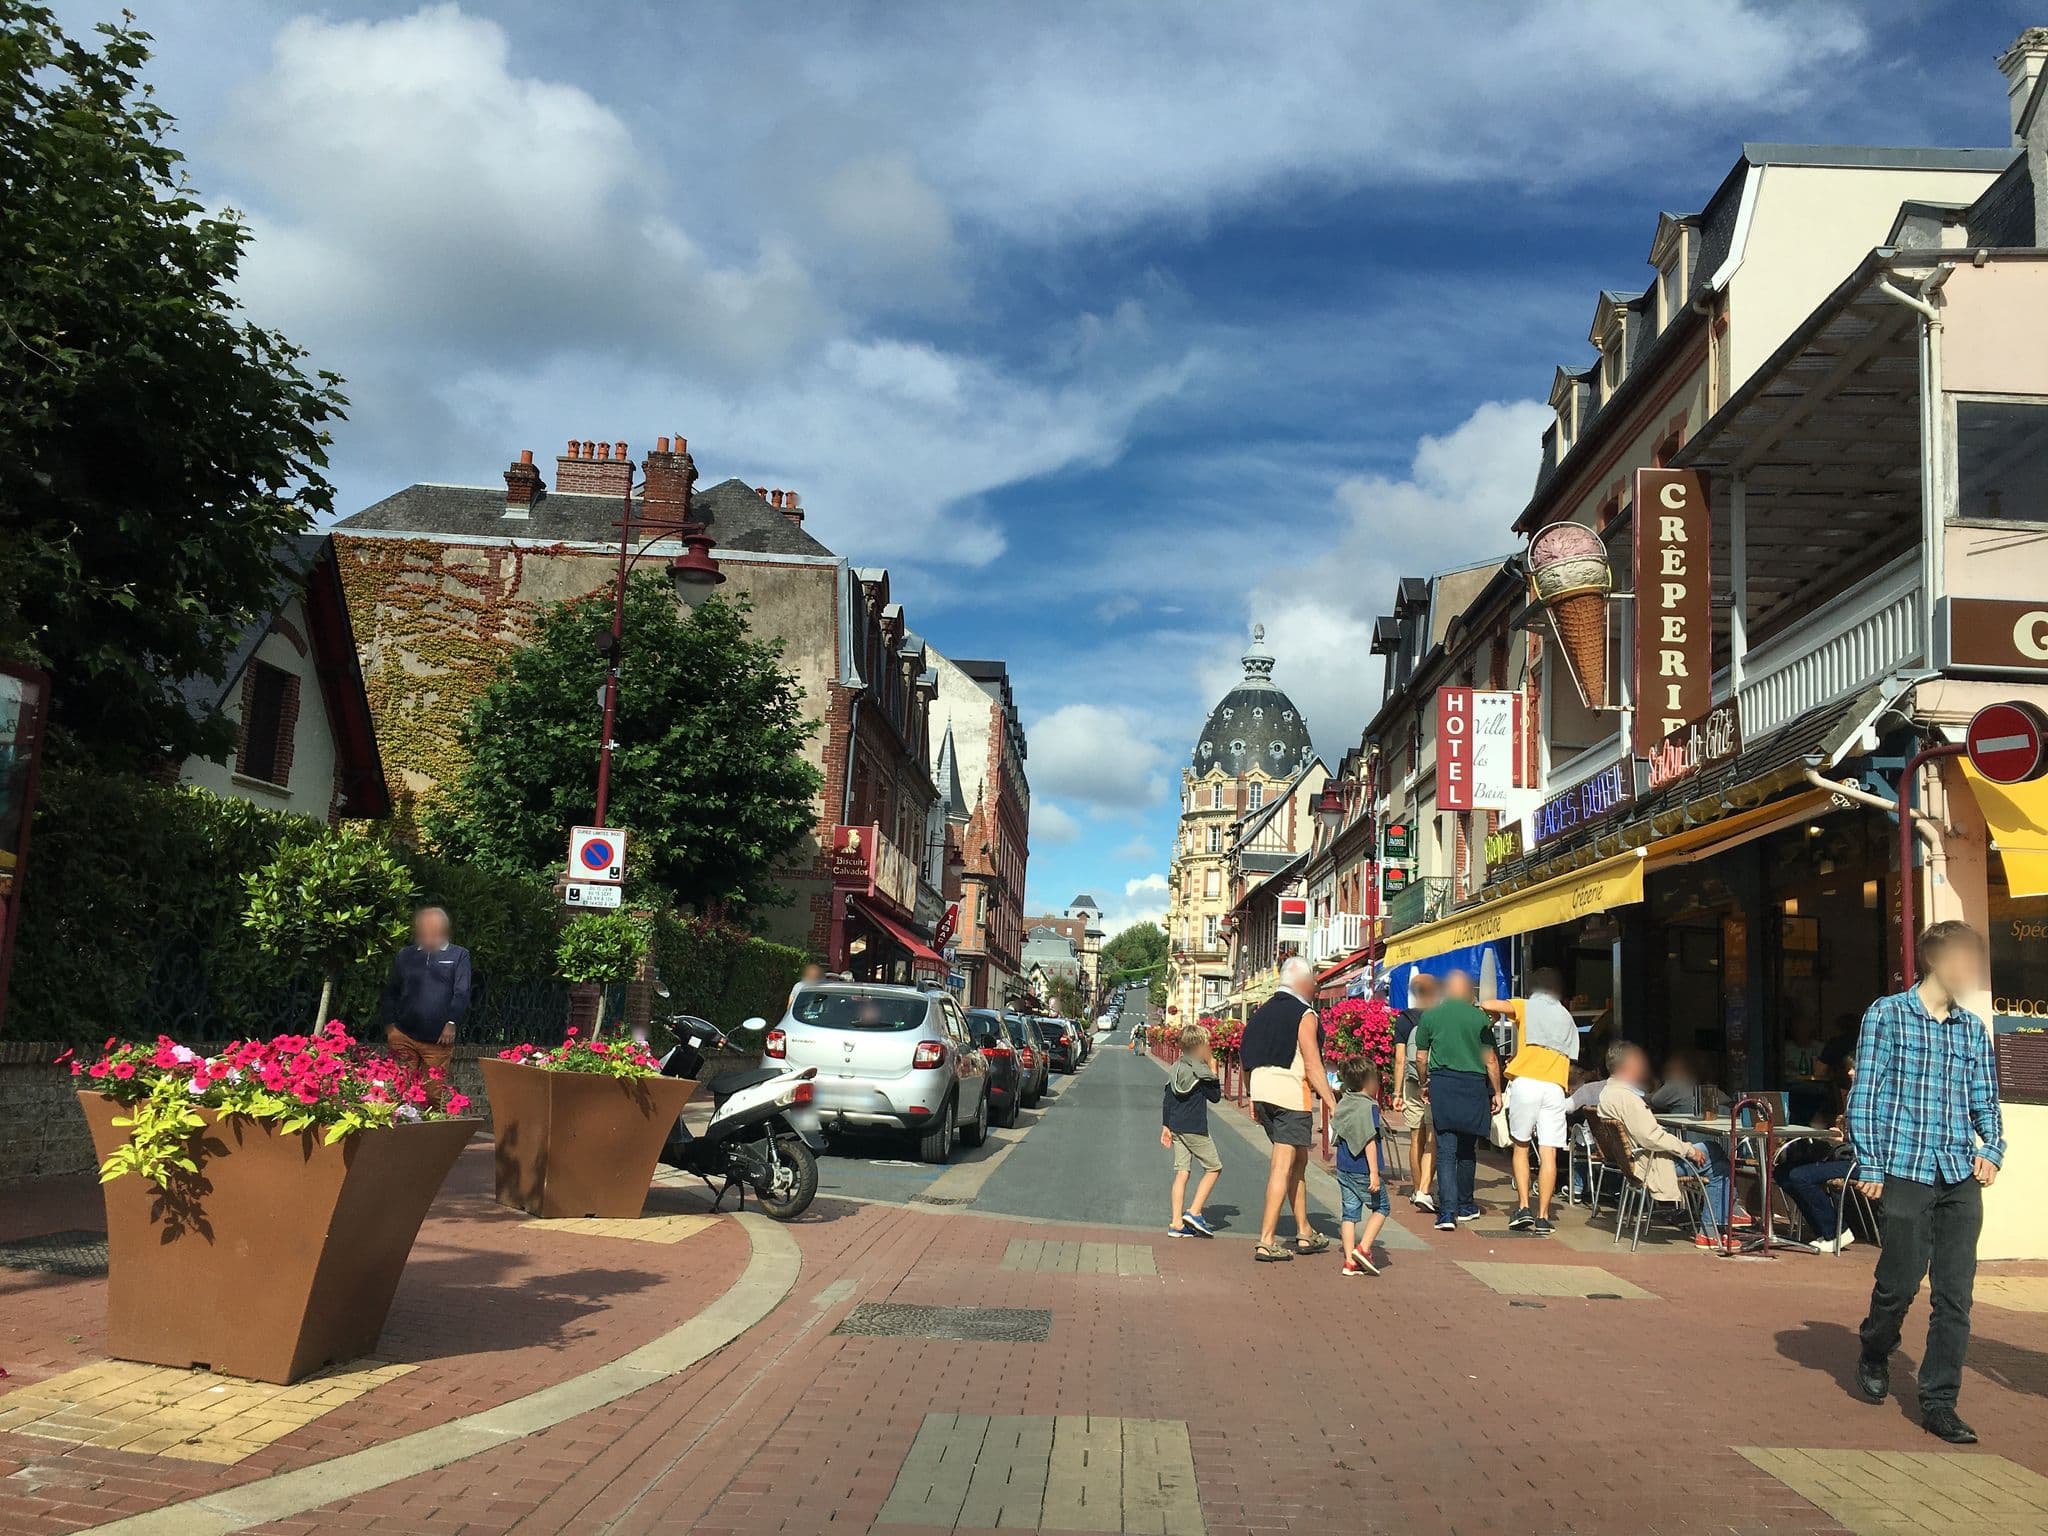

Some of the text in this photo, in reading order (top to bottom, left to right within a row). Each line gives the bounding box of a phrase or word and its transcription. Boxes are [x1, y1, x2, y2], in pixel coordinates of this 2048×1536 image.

[1474, 712, 1507, 736] Villa
[1446, 693, 1464, 804] HOTEL
[1473, 743, 1489, 767] les
[833, 866, 869, 876] Calvados
[836, 856, 867, 867] Biscuits
[937, 914, 954, 944] TABAC
[1993, 997, 2048, 1017] CHOC
